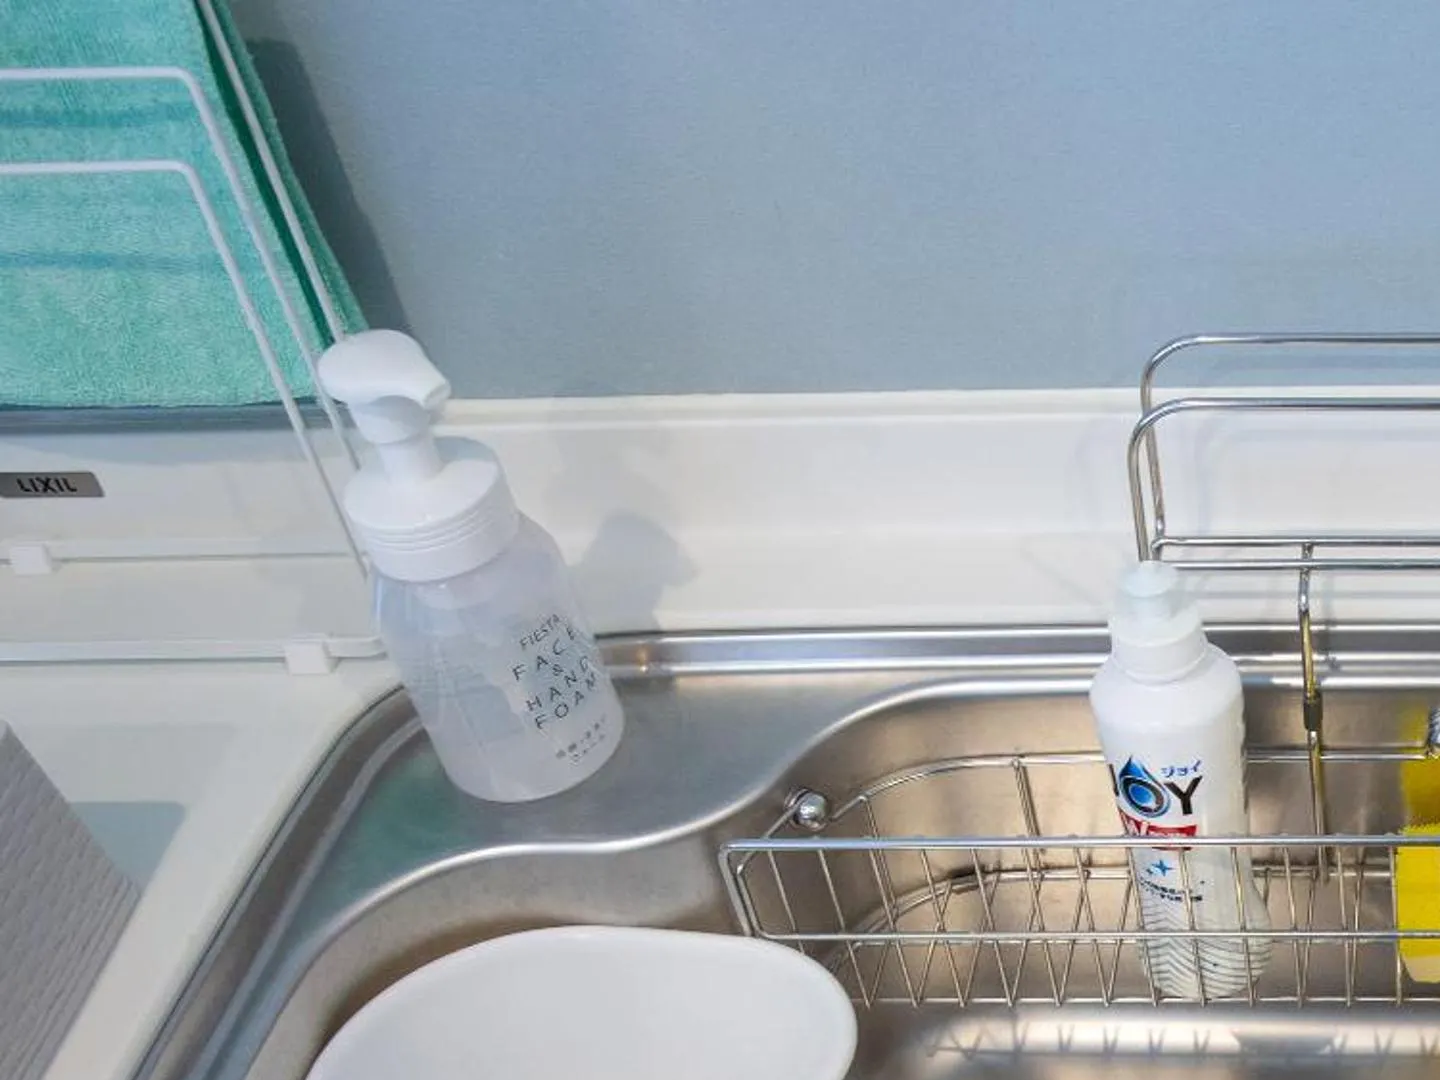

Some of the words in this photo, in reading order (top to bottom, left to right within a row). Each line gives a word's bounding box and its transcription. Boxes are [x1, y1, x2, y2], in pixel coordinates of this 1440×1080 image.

[16, 477, 78, 493] LIXIL
[512, 625, 576, 681] FACE
[526, 655, 589, 711] HAND
